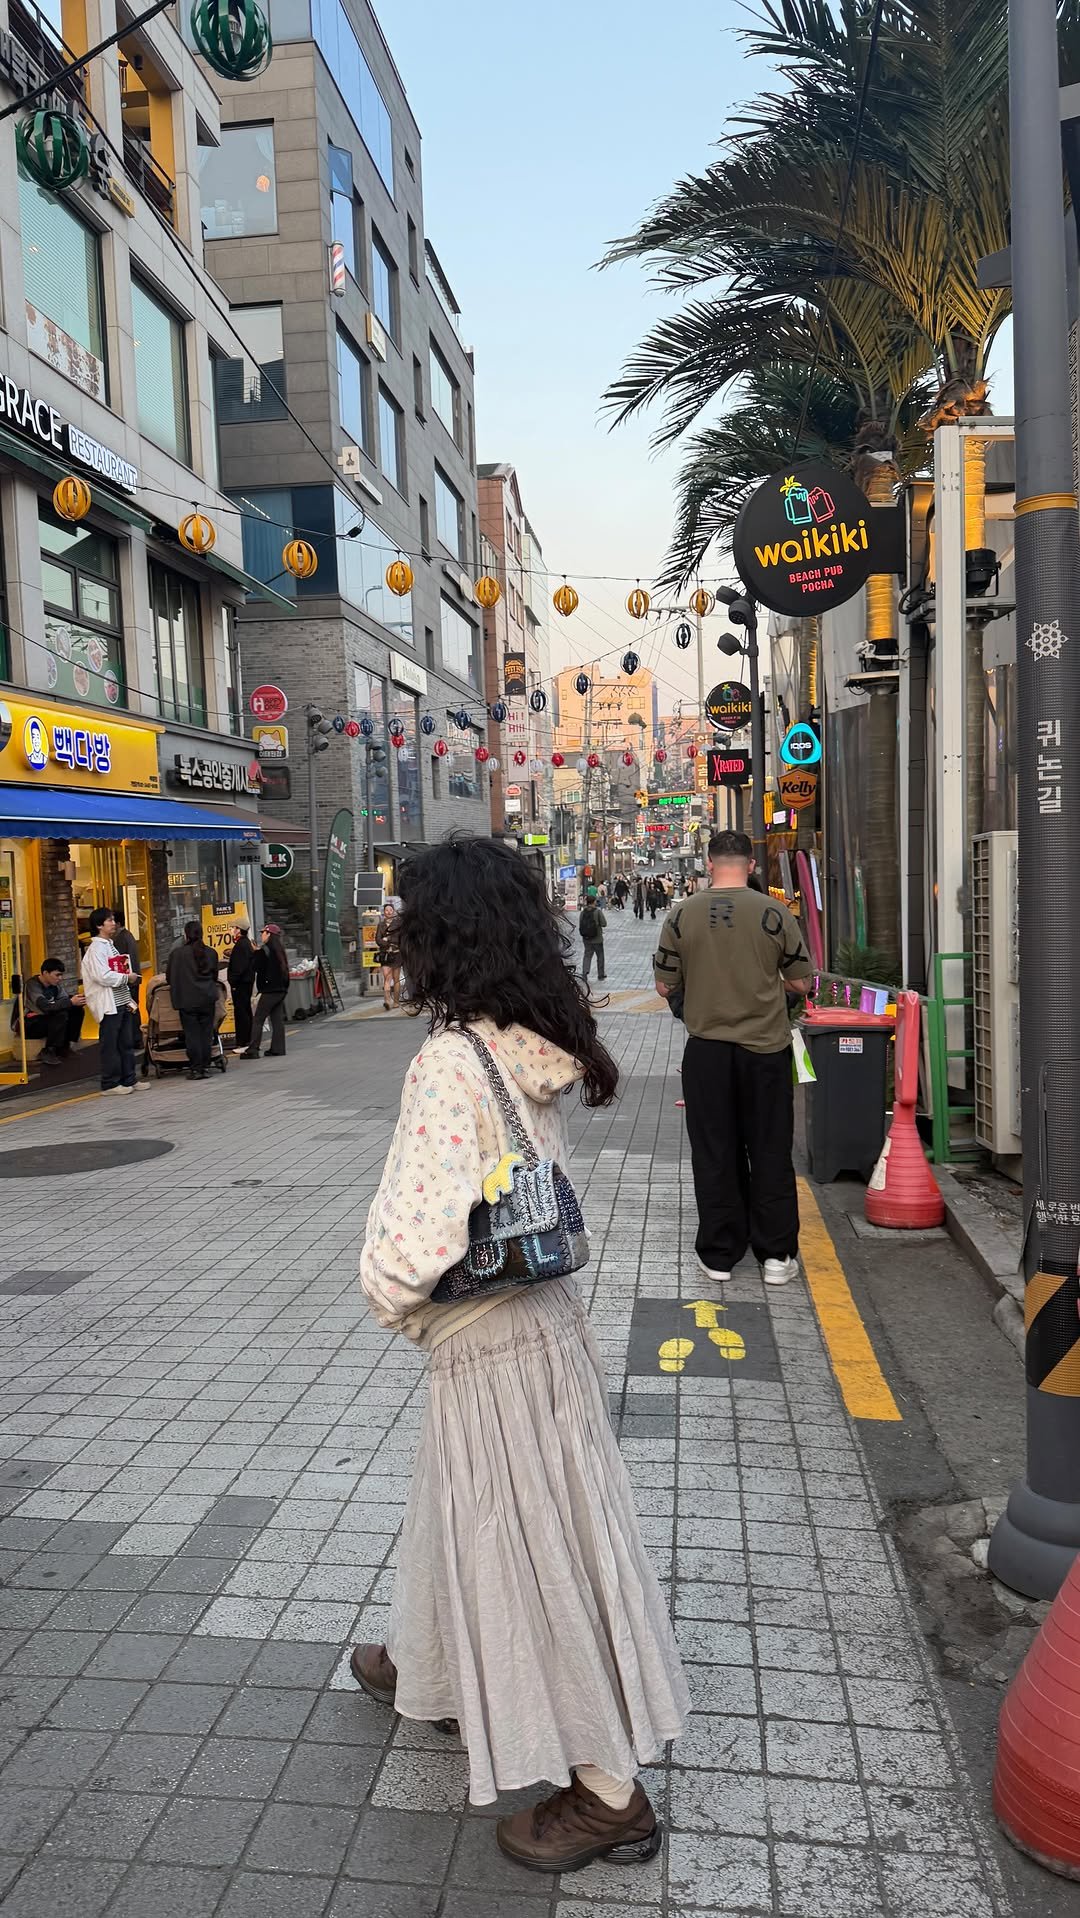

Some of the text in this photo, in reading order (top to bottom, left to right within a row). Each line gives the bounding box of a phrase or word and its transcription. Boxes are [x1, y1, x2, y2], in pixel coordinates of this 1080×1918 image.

[70, 428, 136, 486] RESTAURANT
[754, 519, 868, 568] waikiki
[788, 565, 843, 584] BEACH PUB
[801, 579, 834, 593] POCHA
[710, 701, 752, 715] waikiki
[53, 725, 111, 773] 빽다방
[790, 742, 812, 750] IQOS
[781, 781, 816, 797] Kelly
[207, 923, 232, 933] 아메리
